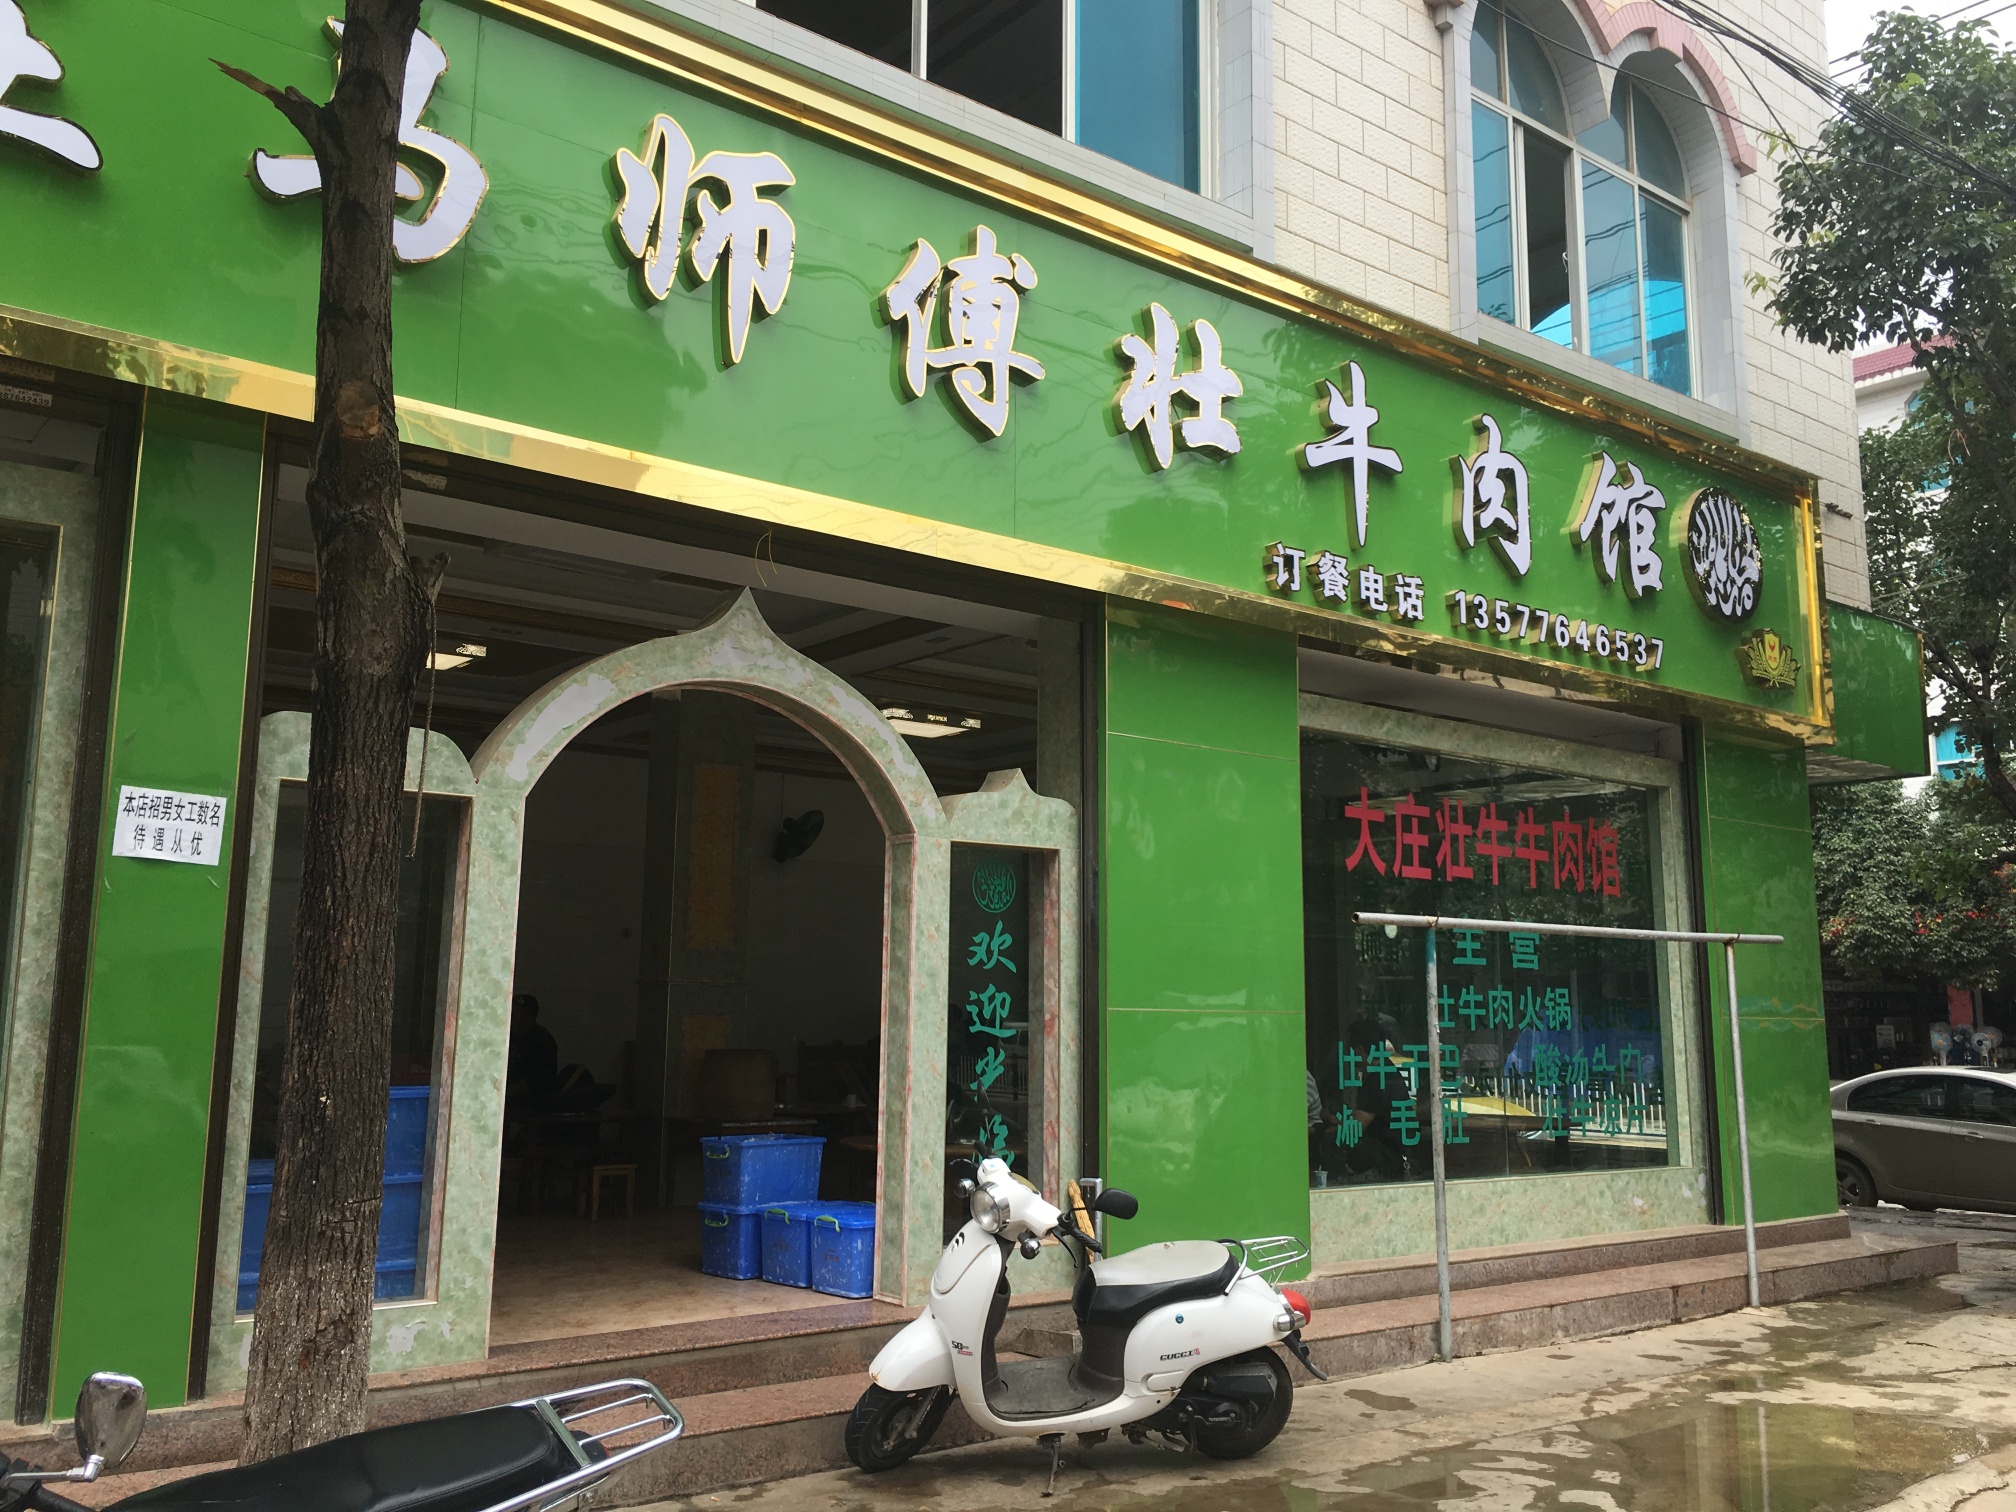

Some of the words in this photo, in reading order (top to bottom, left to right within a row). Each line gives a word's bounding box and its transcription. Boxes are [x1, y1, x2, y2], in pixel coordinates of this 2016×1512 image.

[1270, 541, 1426, 621] 订餐电话
[1453, 590, 1665, 670] 13577646537
[122, 791, 221, 828] 本店招男女工数名
[132, 823, 203, 857] 待遇从优
[1344, 786, 1622, 897] 大庄壮牛牛肉馆
